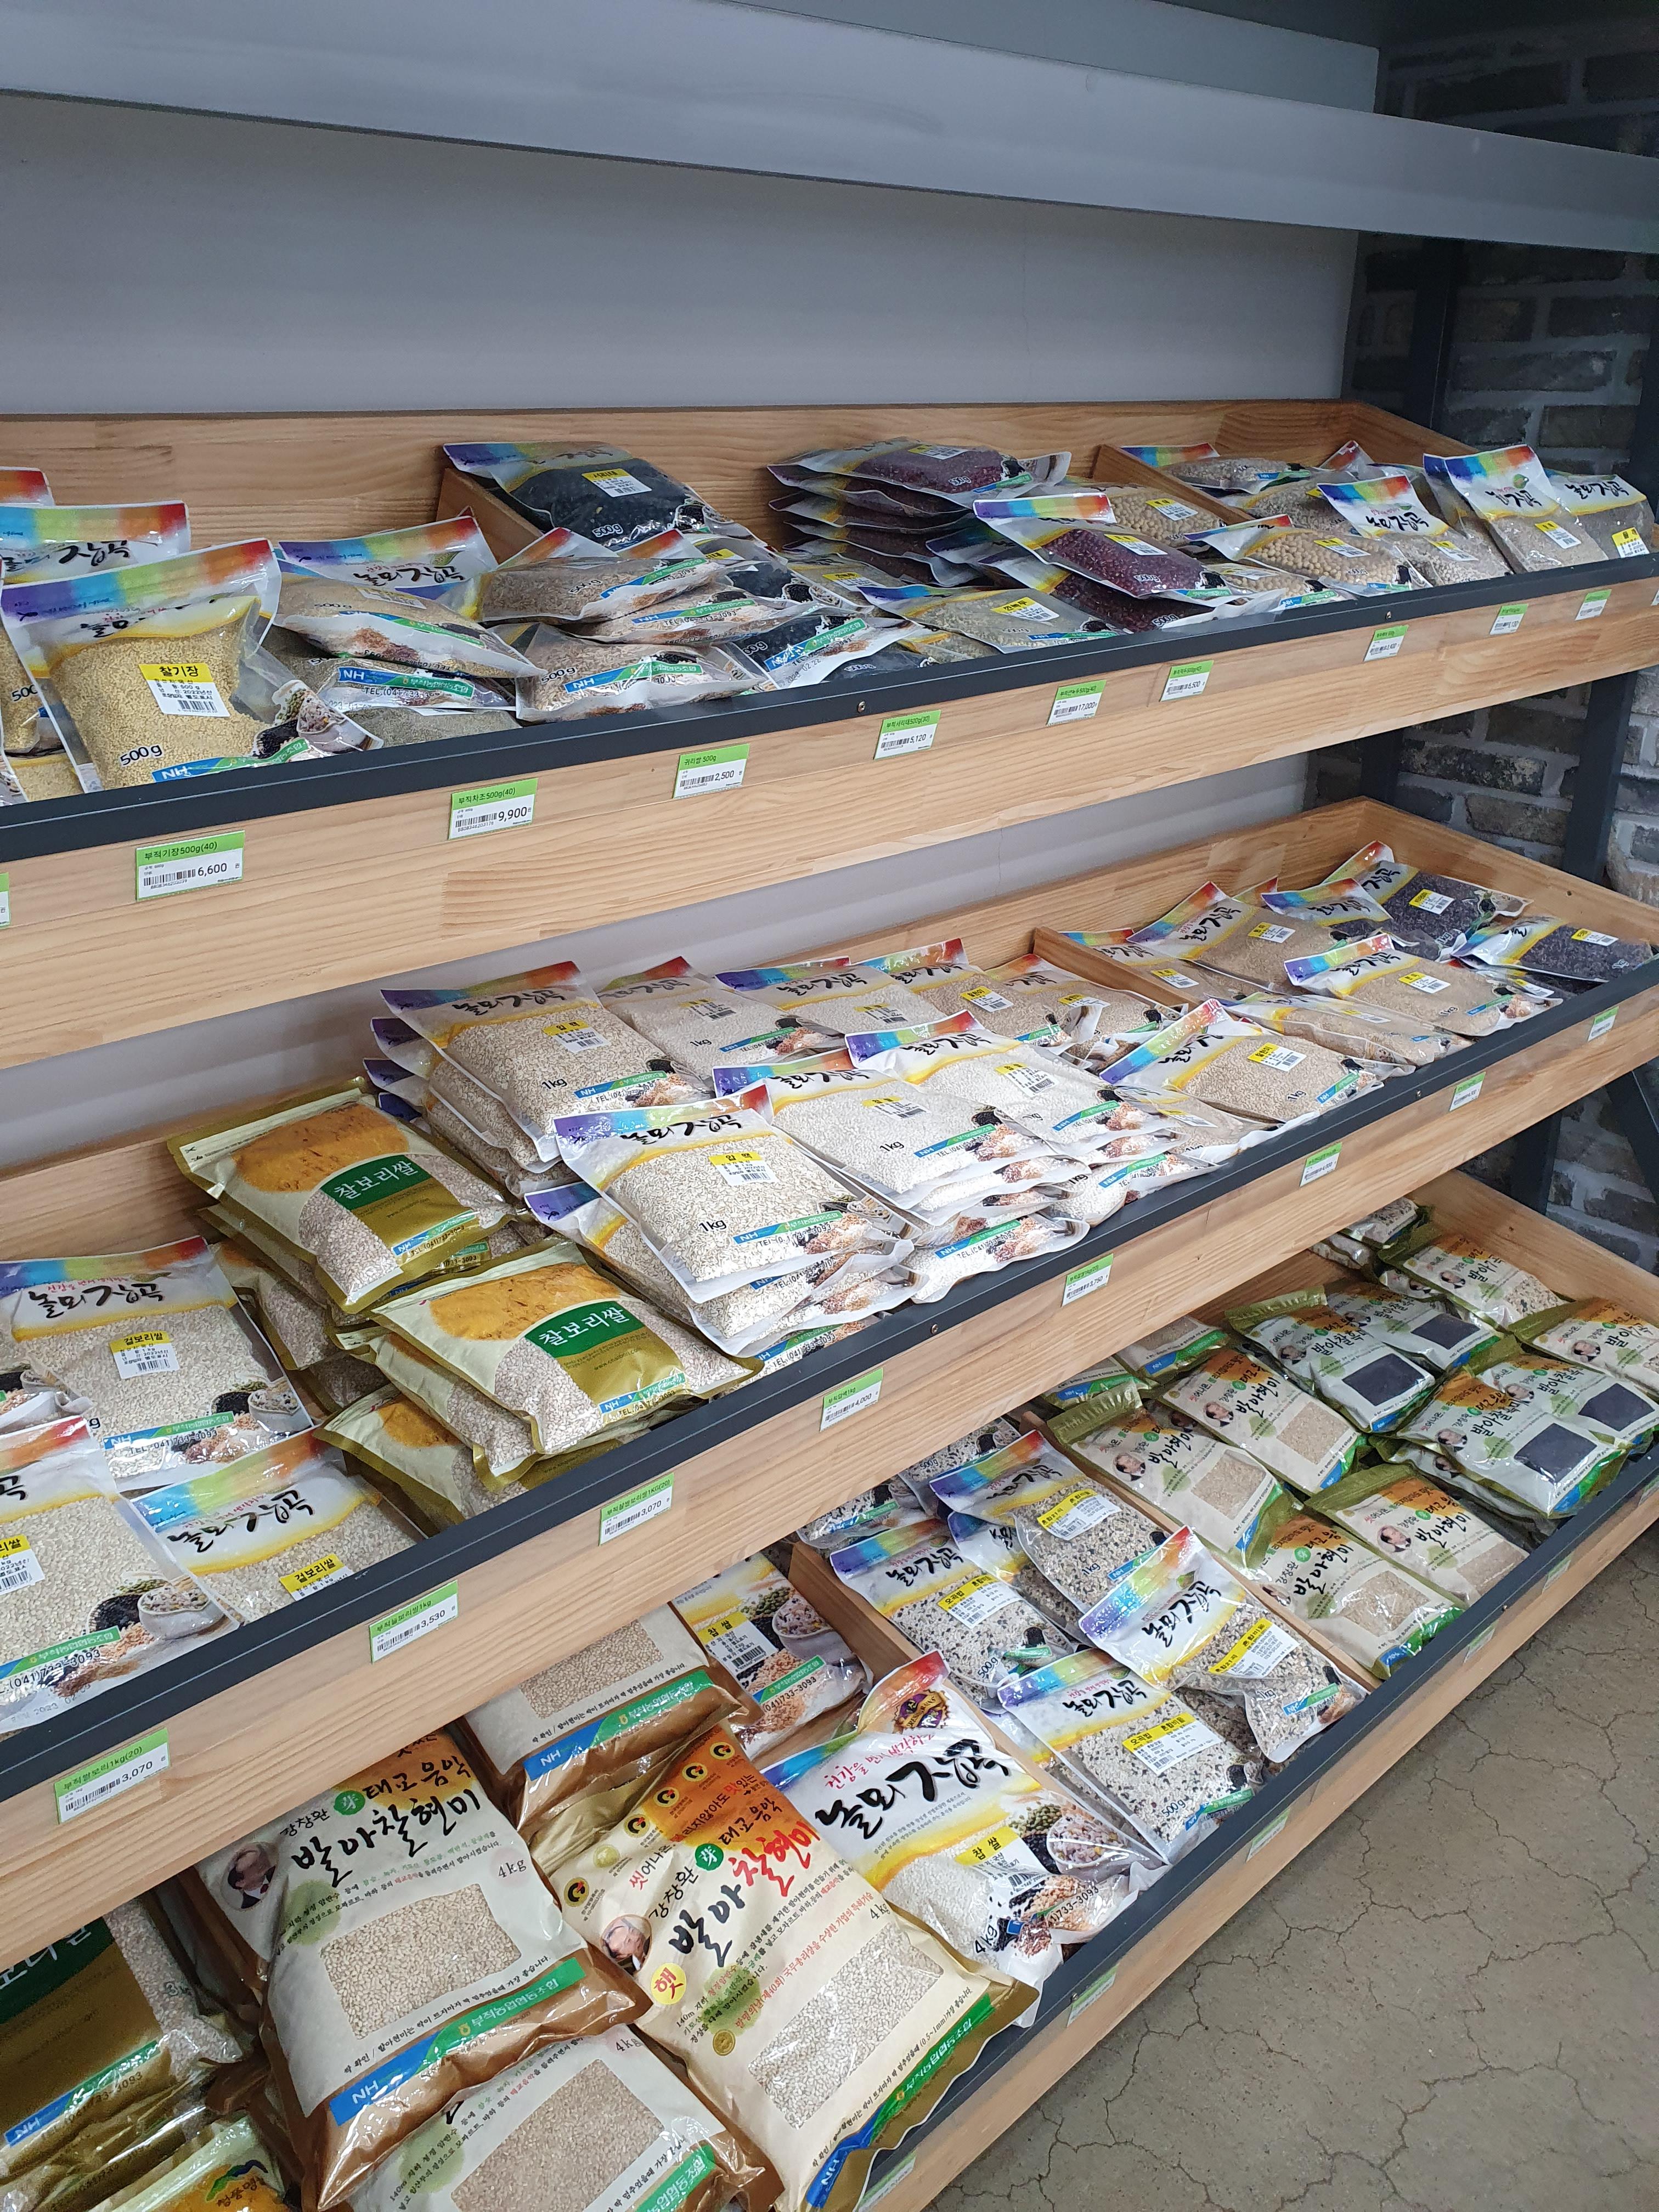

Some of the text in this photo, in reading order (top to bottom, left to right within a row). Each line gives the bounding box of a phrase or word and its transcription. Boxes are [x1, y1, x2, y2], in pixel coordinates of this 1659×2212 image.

[593, 523, 623, 537] 500g
[159, 665, 199, 677] 찰기장
[343, 670, 365, 680] NH
[540, 667, 576, 684] 500g
[573, 678, 595, 690] NH
[1078, 702, 1096, 711] 17,000
[910, 733, 926, 743] 5,120
[120, 745, 162, 766] 500g
[703, 754, 716, 763] 500g
[715, 770, 735, 782] 2,500
[498, 806, 527, 821] 9,900
[144, 841, 218, 861] 부적기장500g(40)
[198, 862, 228, 877] 6,600
[690, 1038, 712, 1047] 1kg
[541, 1077, 567, 1091] 1kg
[579, 1088, 596, 1097] NH
[1287, 1090, 1306, 1102] 1kg
[1320, 1092, 1330, 1102] NH
[879, 1141, 905, 1152] 1kg
[918, 1148, 934, 1156] NH
[334, 1161, 419, 1200] 찰보리쌀
[699, 1218, 727, 1233] 1kg
[739, 1232, 759, 1243] NH
[940, 1248, 957, 1257] NH
[29, 1282, 165, 1319] 놀뫼잡곡
[538, 1307, 630, 1346] 찰보리쌀
[605, 1400, 619, 1411] NH
[855, 1393, 872, 1406] 4,000
[919, 1459, 939, 1470] 500g
[641, 1500, 662, 1516] 3,070
[1081, 1562, 1102, 1576] 1kg
[1113, 1568, 1125, 1580] NH
[421, 1610, 445, 1628] 3,530
[977, 1655, 999, 1678] 500g
[540, 1749, 561, 1767] NH
[122, 1761, 153, 1782] 3,070
[1161, 1799, 1186, 1819] 500g
[279, 1808, 330, 1837] 강창완
[291, 1788, 481, 1888] 발아찰현미
[498, 1858, 527, 1878] 4kg
[647, 1866, 699, 1919] 강창완
[974, 1924, 999, 1955] 4kg
[655, 1967, 680, 1999] 햇
[676, 2010, 696, 2028] 140m
[352, 2079, 378, 2104] NH
[821, 2158, 840, 2186] NH
